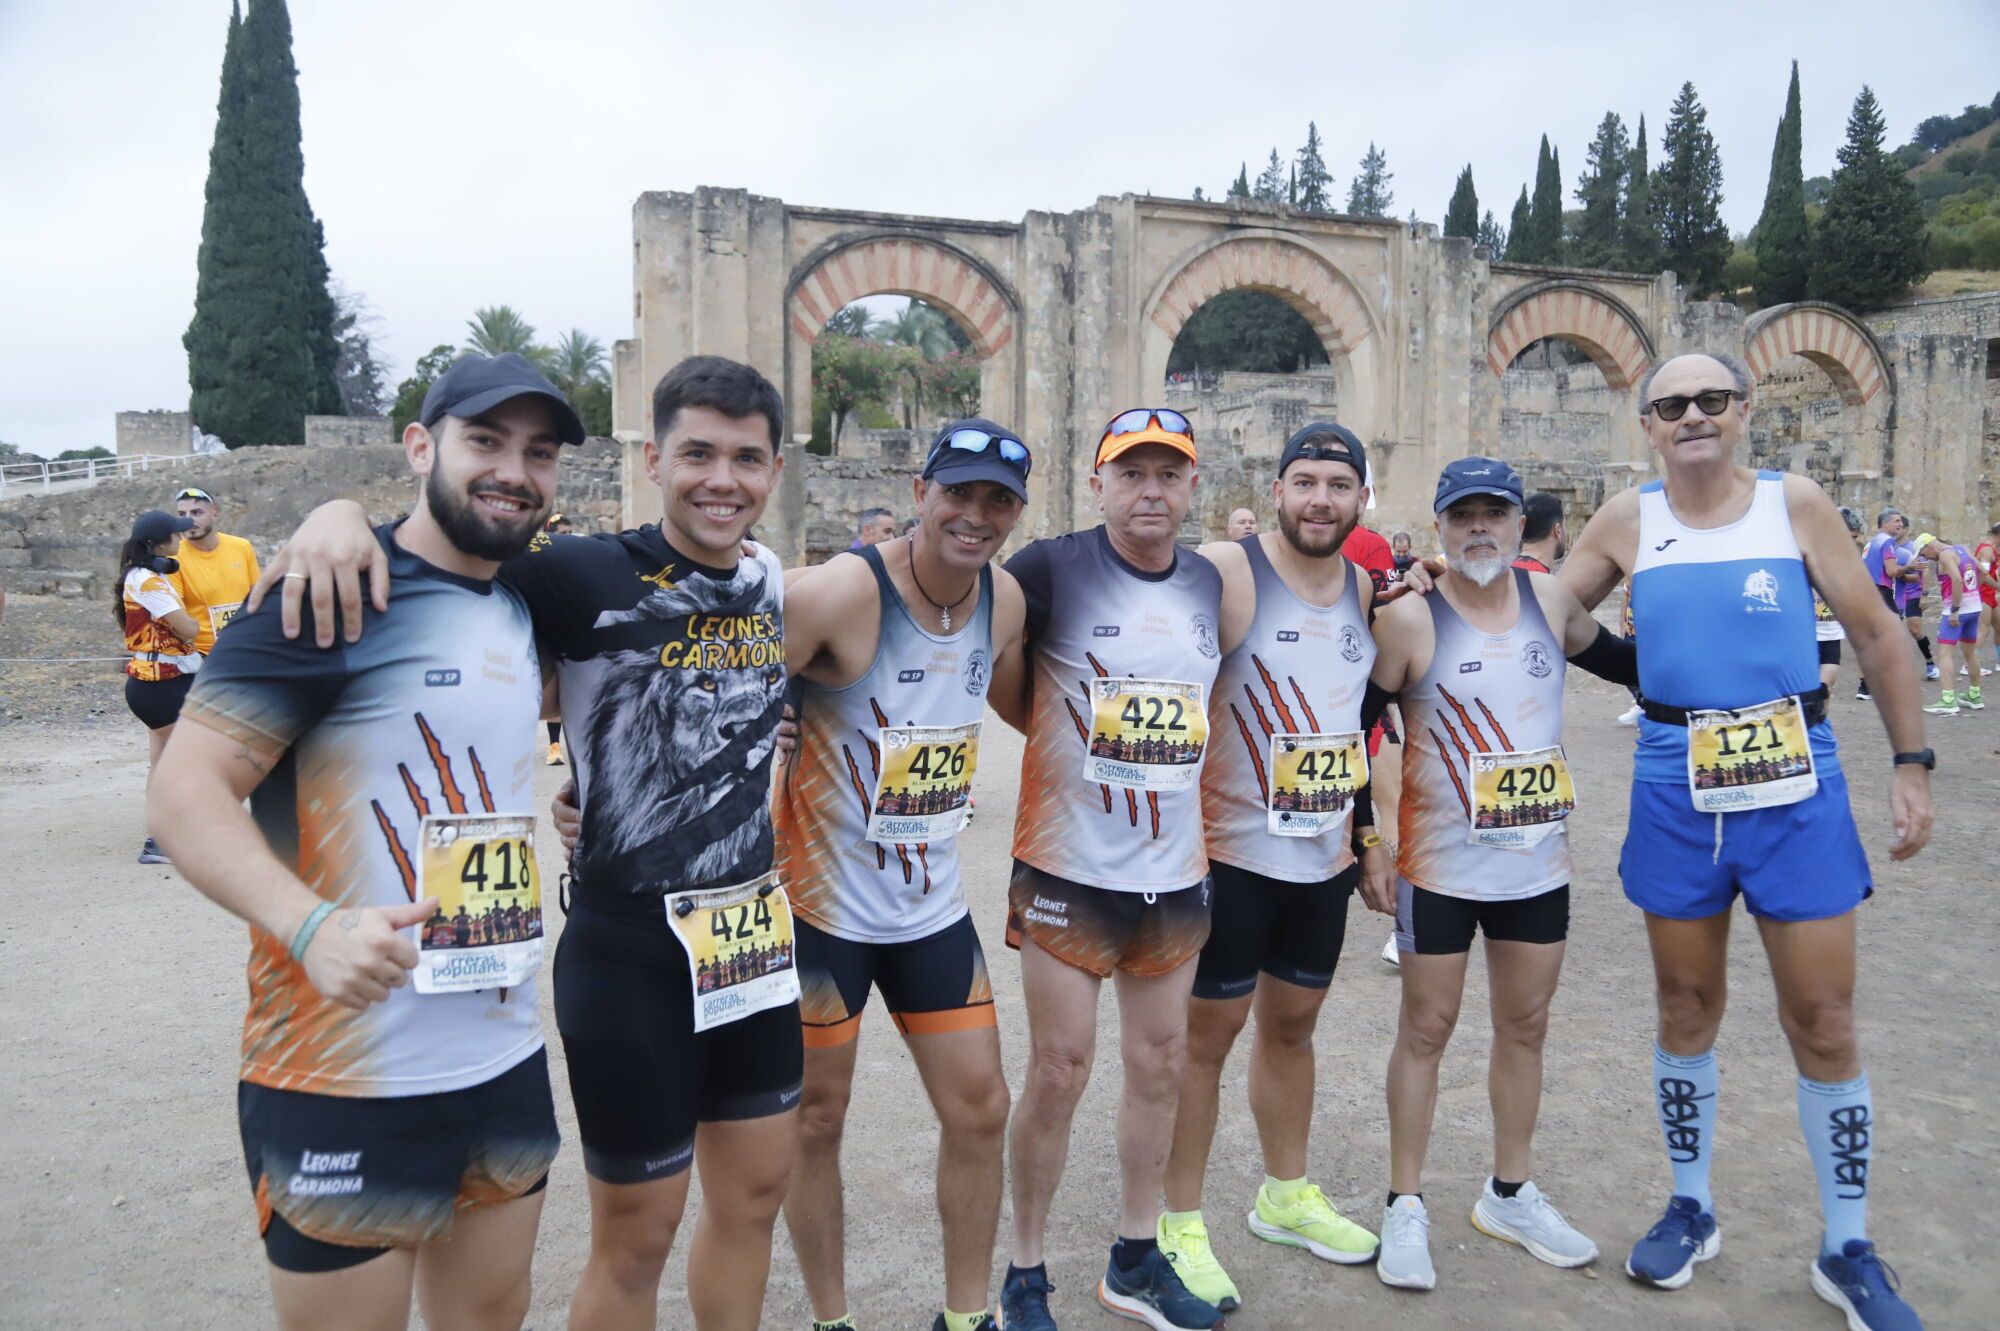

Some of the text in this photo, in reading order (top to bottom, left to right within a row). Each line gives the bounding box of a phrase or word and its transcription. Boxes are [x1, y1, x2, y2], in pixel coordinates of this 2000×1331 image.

[686, 613, 775, 641] LEONES
[1121, 697, 1187, 731] 422
[1715, 719, 1783, 756] 121
[908, 743, 967, 781] 426
[1297, 749, 1351, 781] 421
[1477, 759, 1496, 772] 39
[1497, 764, 1556, 797] 420
[878, 826, 929, 835] opulares
[461, 840, 530, 892] 418
[1033, 894, 1067, 913] LEONES
[711, 899, 772, 942] 424
[1024, 908, 1069, 927] CARMONA
[432, 953, 496, 969] rreras
[432, 962, 507, 980] populares
[703, 991, 739, 1008] carreras
[704, 997, 747, 1018] populares
[1659, 1077, 1716, 1163] eleven
[301, 1150, 363, 1172] LEONES
[1829, 1104, 1873, 1200] eleven
[289, 1175, 363, 1195] CARMONA
